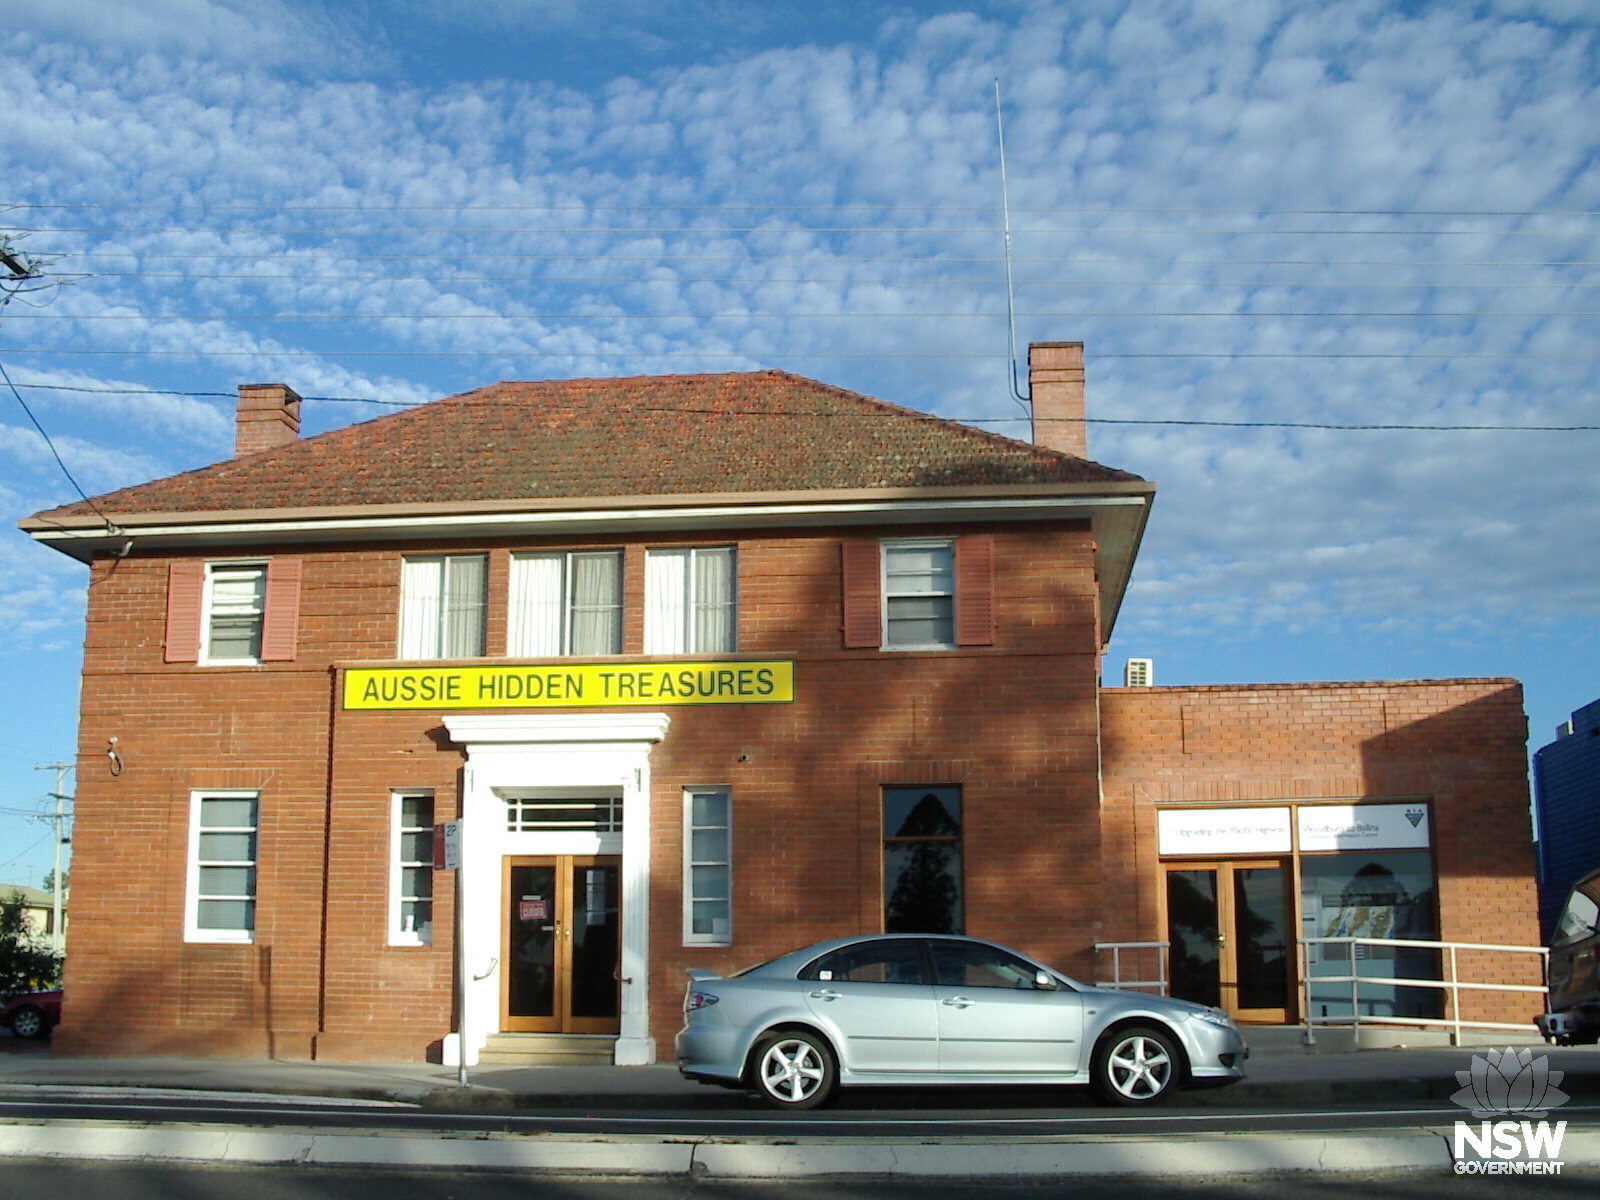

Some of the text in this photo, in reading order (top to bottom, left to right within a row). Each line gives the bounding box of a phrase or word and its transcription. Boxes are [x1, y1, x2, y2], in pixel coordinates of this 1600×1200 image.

[363, 669, 774, 702] AUSSIE HIDDEN TREASURES
